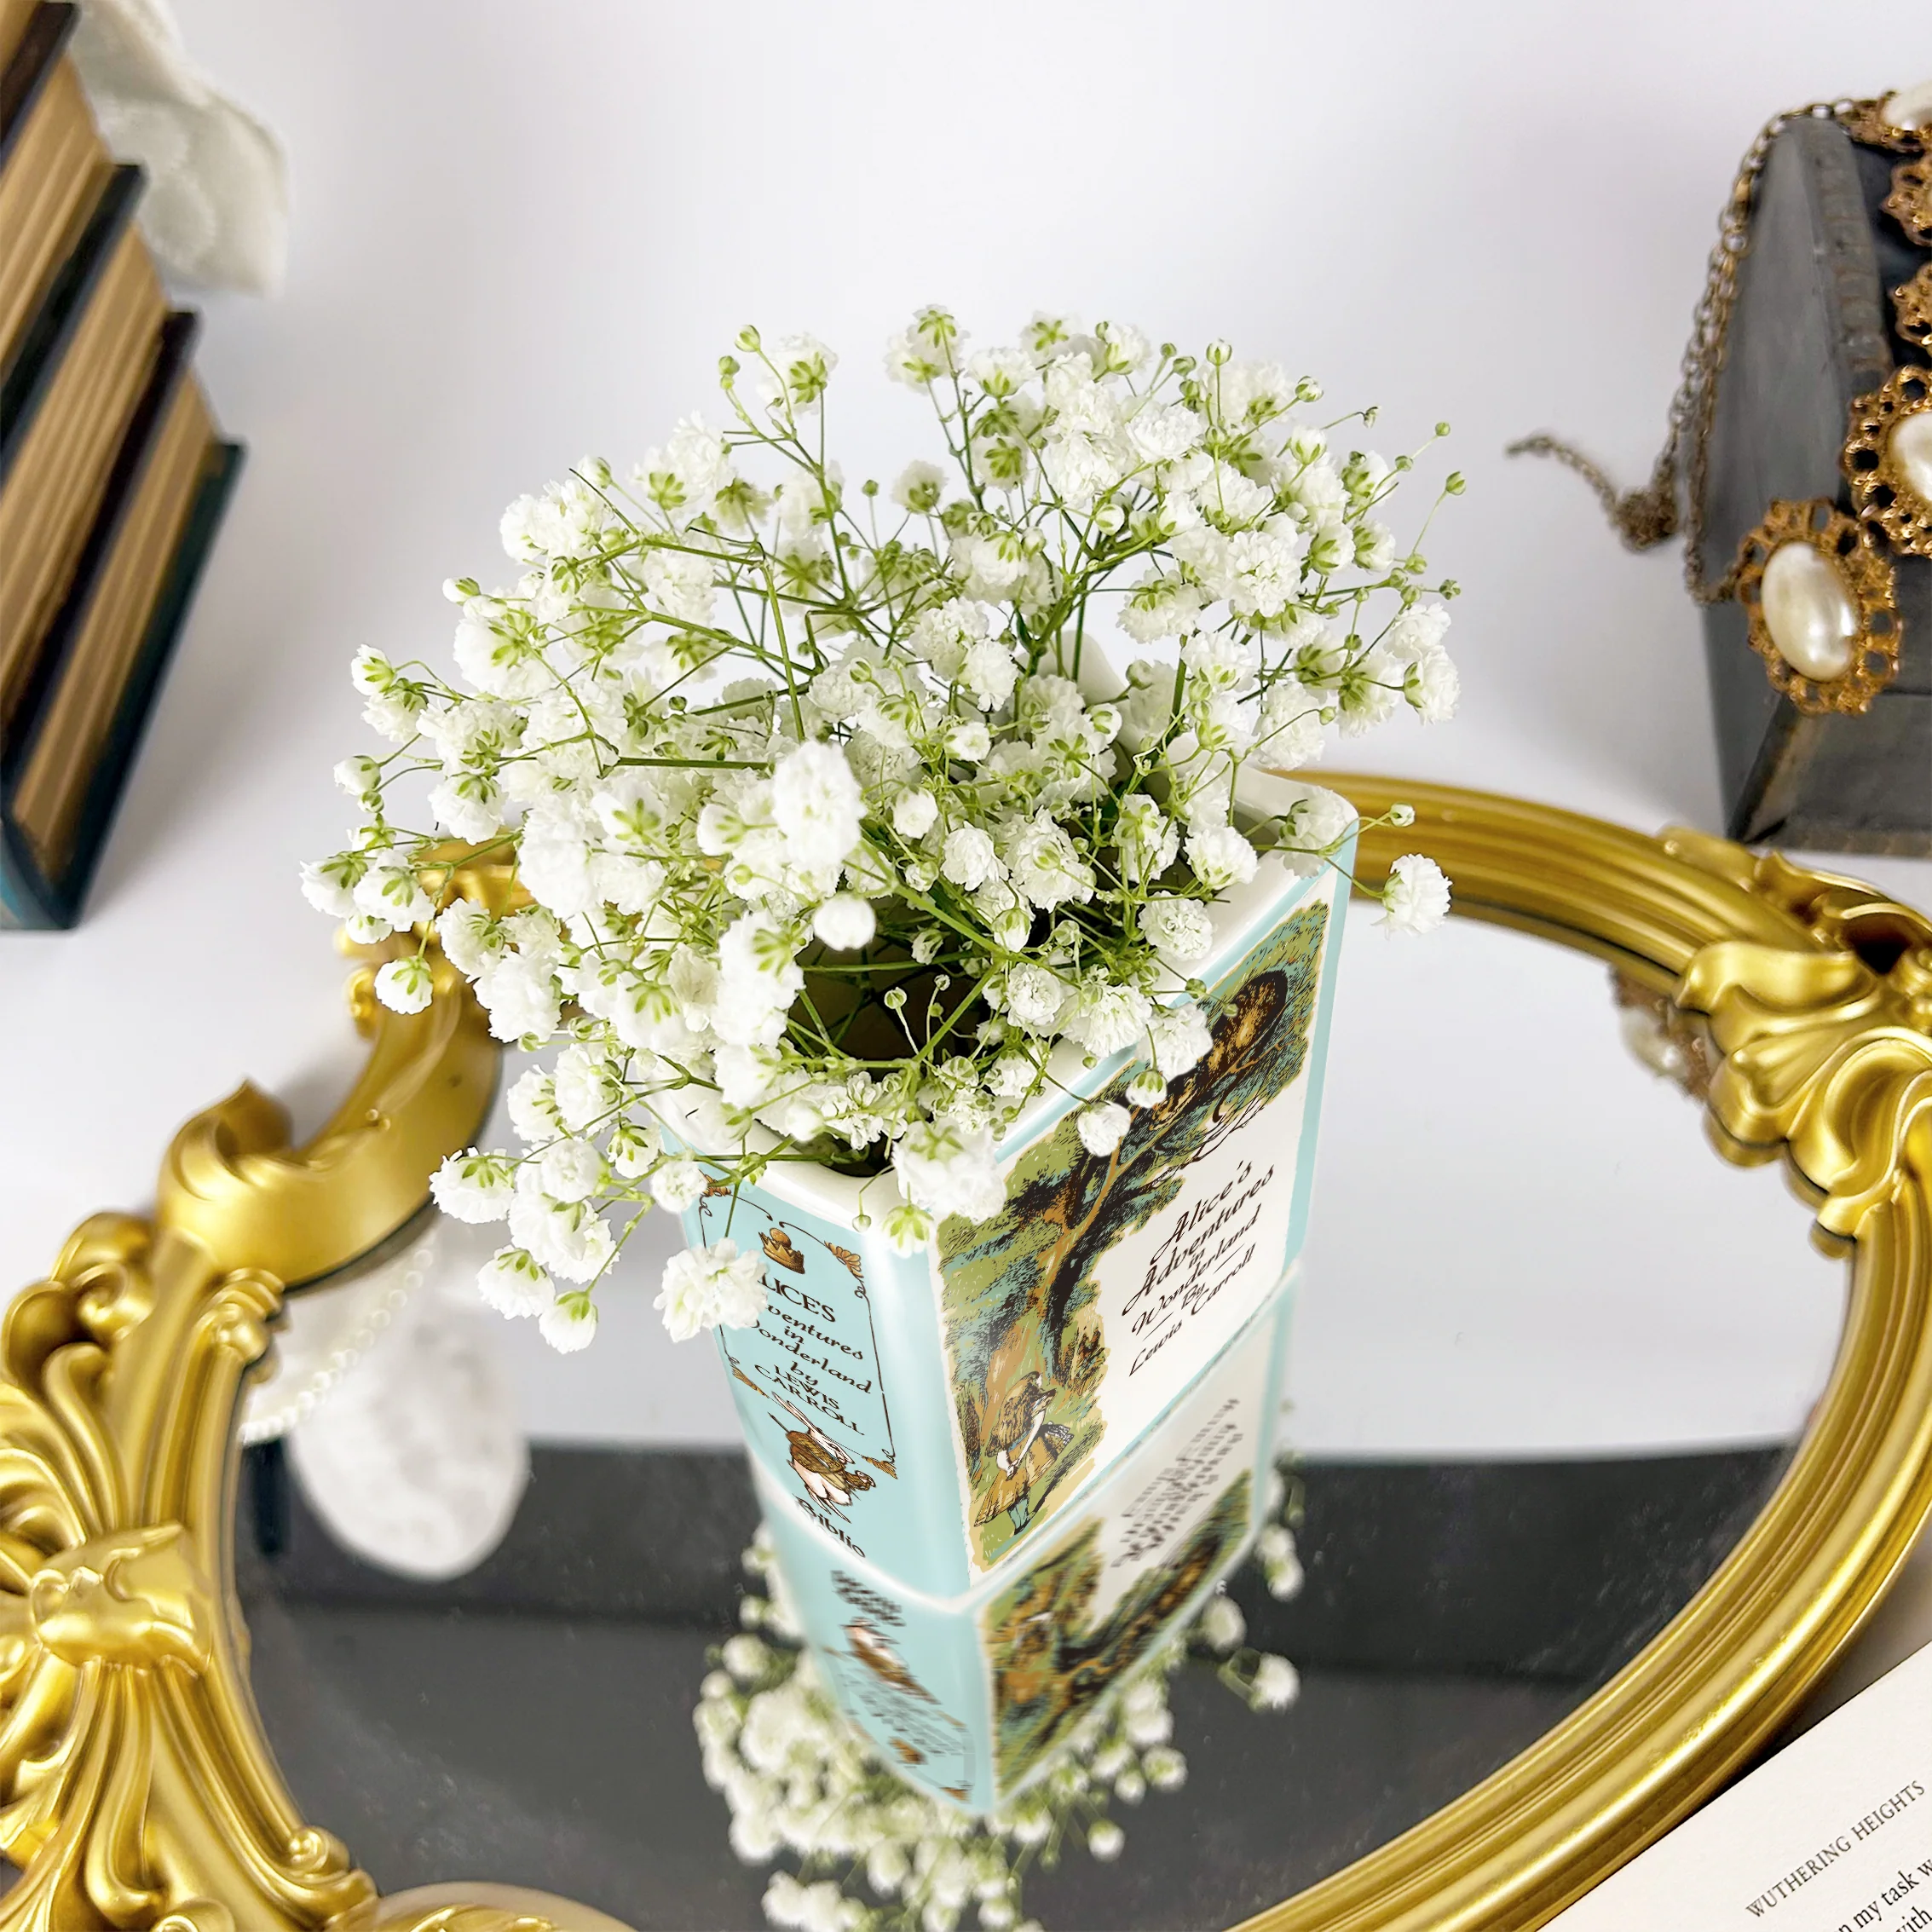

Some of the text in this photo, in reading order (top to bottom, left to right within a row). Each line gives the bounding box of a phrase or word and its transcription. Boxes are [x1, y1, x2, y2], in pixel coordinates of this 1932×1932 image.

[1122, 1164, 1275, 1316] Adventures
[1151, 1160, 1253, 1266] Alice's
[1131, 1202, 1261, 1335] Wonderland
[1188, 1248, 1206, 1270] in
[758, 1273, 836, 1322] LICE'S
[1129, 1319, 1183, 1376] Lewis
[1191, 1242, 1257, 1316] Carroll
[1181, 1283, 1206, 1310] By
[751, 1319, 872, 1393] onderland
[766, 1304, 863, 1360] ventures
[784, 1325, 804, 1345] in
[754, 1364, 865, 1436] CARROLL
[774, 1364, 839, 1410] LEWIS
[791, 1361, 818, 1386] by
[1745, 1780, 1925, 1918] WUTHERING HEIGHTS
[1853, 1900, 1883, 1929] my
[1881, 1870, 1920, 1906] task
